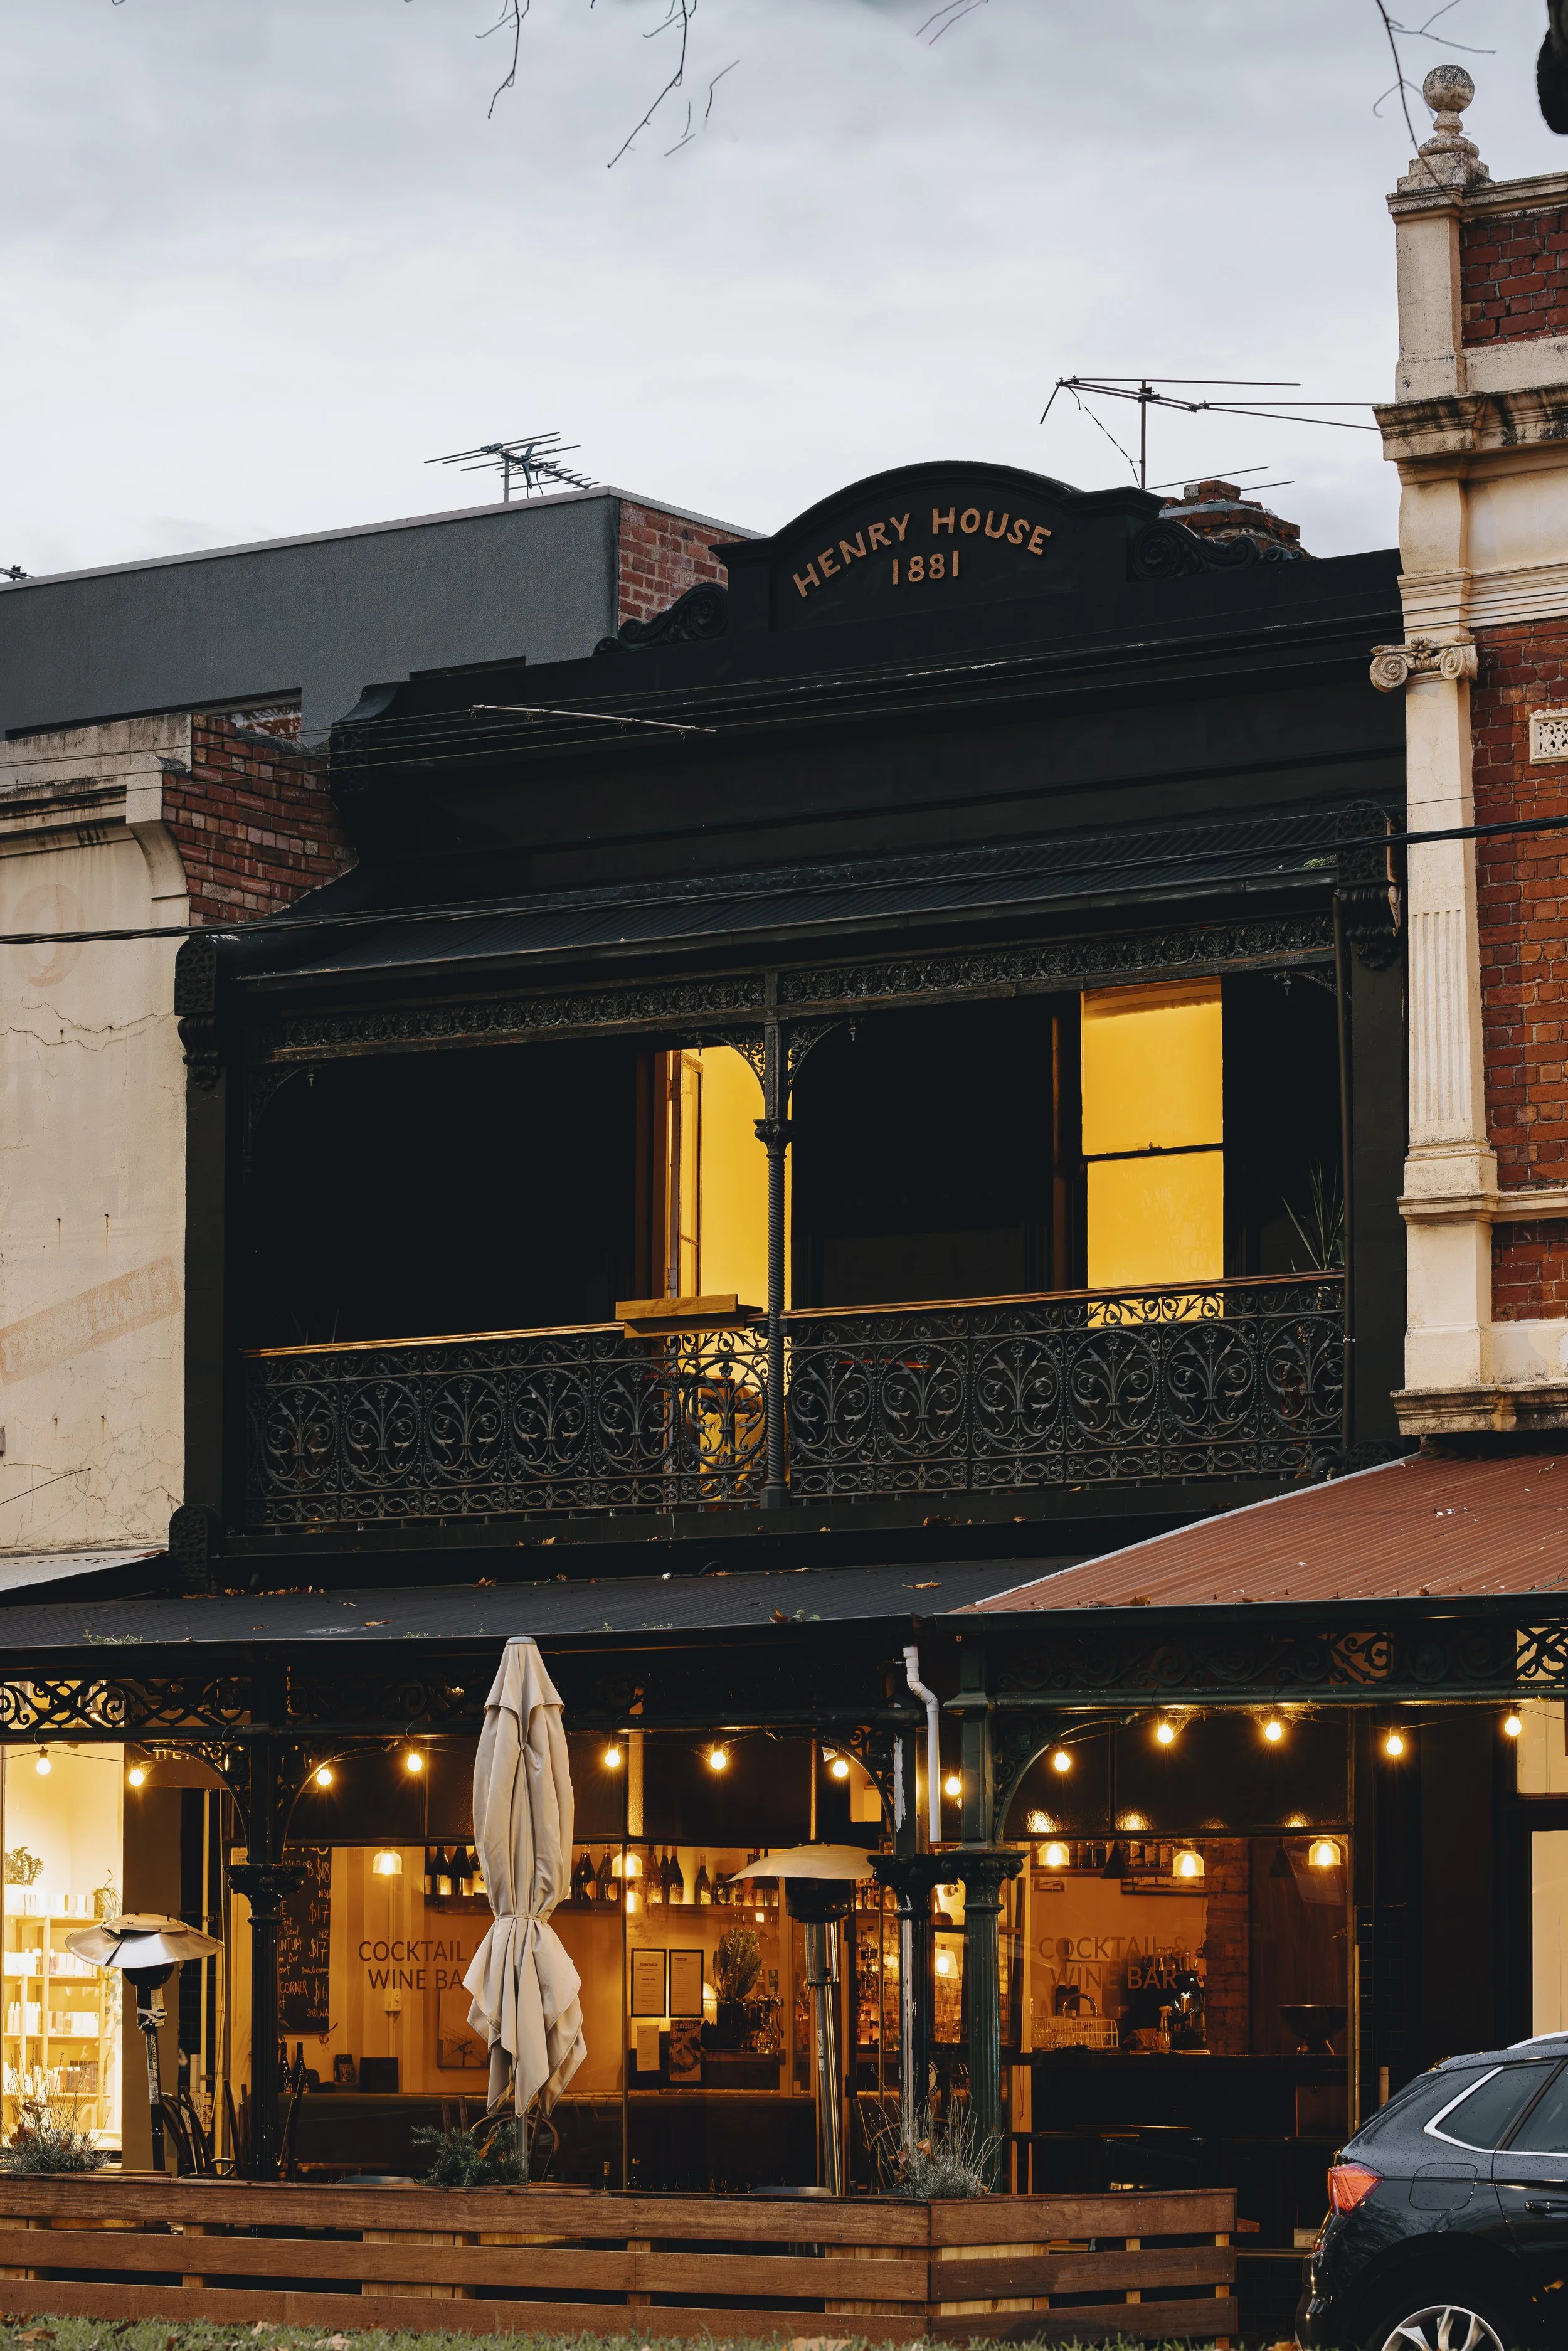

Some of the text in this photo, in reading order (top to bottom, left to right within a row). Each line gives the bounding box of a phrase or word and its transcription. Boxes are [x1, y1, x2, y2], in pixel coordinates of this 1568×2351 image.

[792, 507, 1052, 598] HENRY HOUSE
[892, 550, 960, 585] 1881
[315, 1855, 331, 1886] $18
[308, 1899, 330, 1925] $17
[319, 1929, 331, 1940] NZ
[308, 1938, 329, 1965] $17
[358, 1940, 467, 1962] COCKTAIL
[1038, 1936, 1160, 1960] COCKTAIL
[280, 1979, 309, 1998] CORNER
[368, 1968, 469, 1990] WINE BA
[1049, 1966, 1178, 1990] WINE BAR
[313, 1978, 327, 2007] $16
